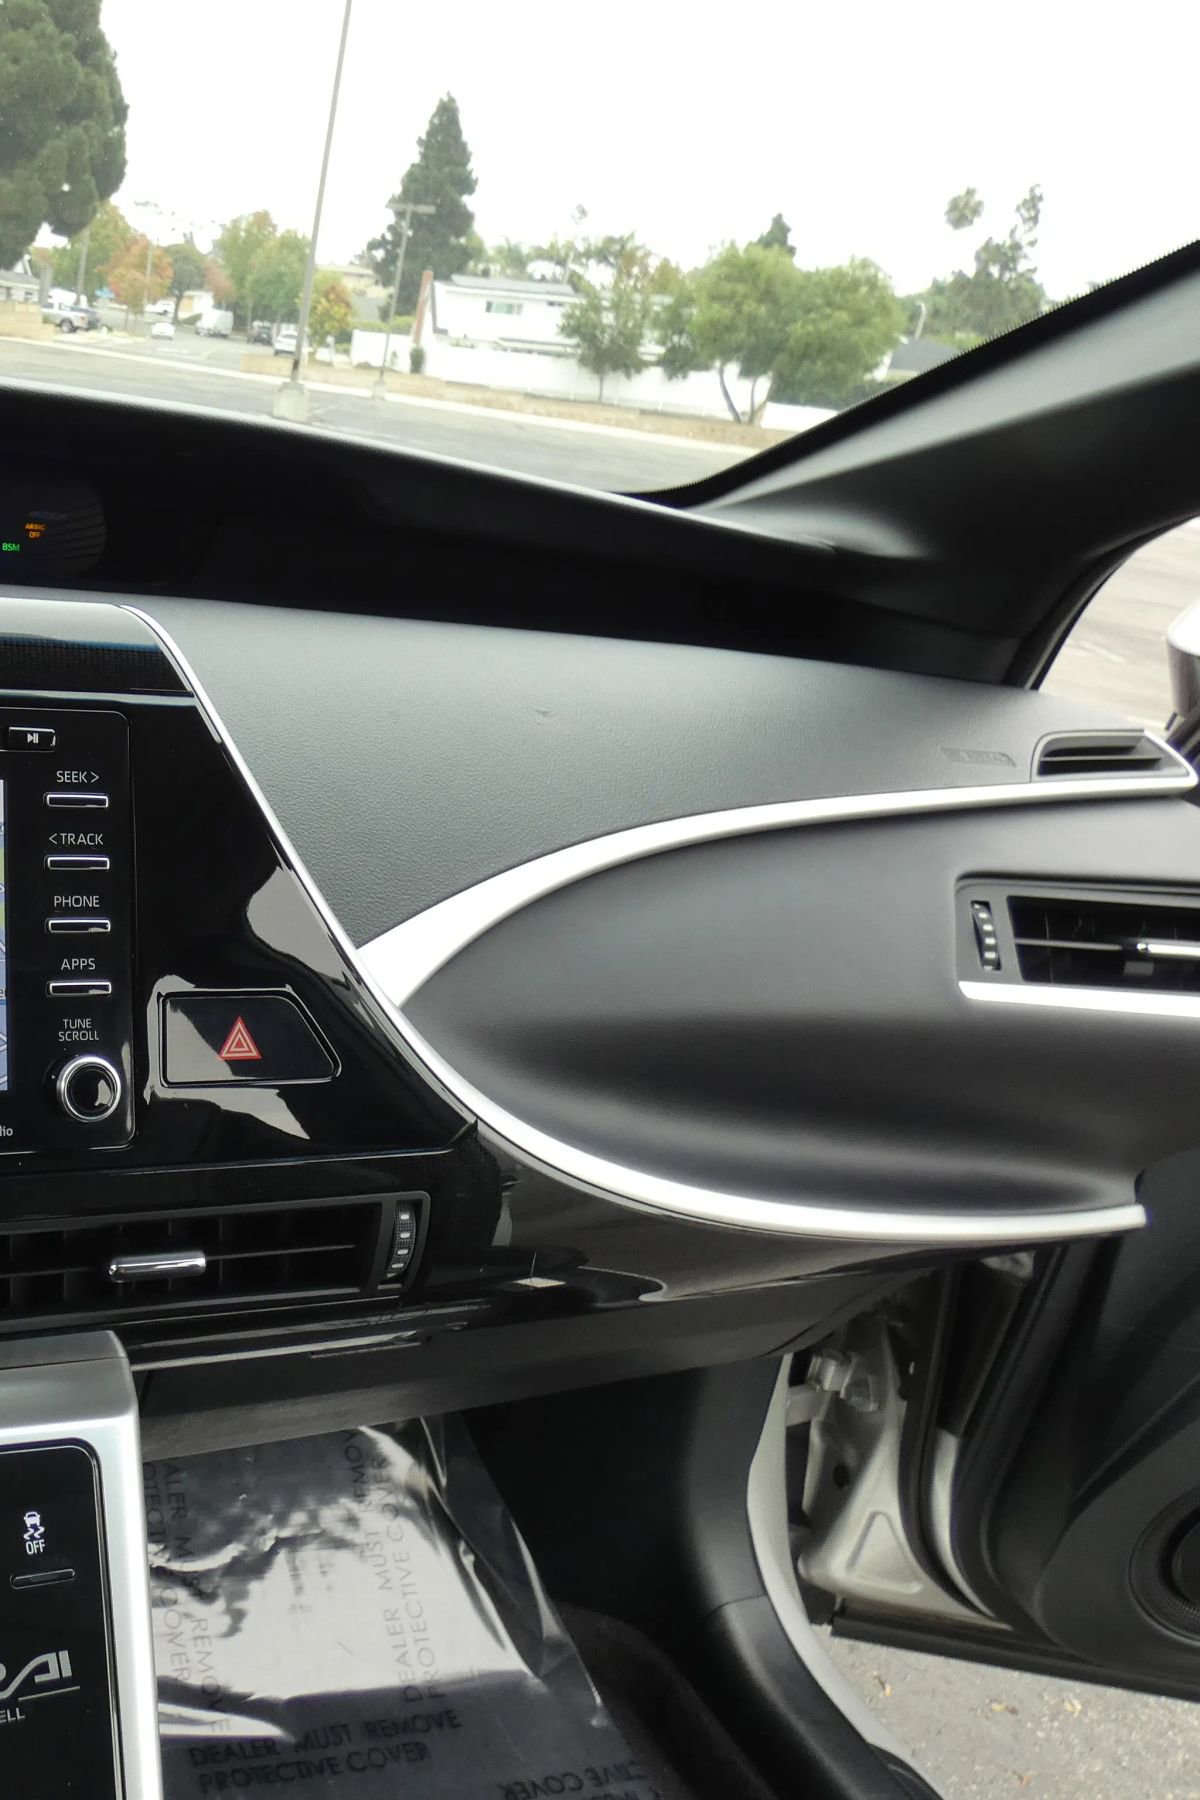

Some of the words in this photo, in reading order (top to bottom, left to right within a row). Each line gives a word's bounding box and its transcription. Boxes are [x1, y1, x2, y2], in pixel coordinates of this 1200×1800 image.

[2, 543, 21, 552] BSM
[53, 895, 100, 908] PHONE
[61, 958, 97, 971] APPS
[62, 1018, 92, 1030] TUNE
[58, 1030, 100, 1042] SCROLL
[25, 1539, 46, 1555] OFF
[364, 1531, 393, 1592] MUST
[382, 1606, 424, 1703] DEALER
[188, 1738, 280, 1768] DEALER
[293, 1723, 352, 1754] MUST
[362, 1708, 463, 1739] REMOVE
[197, 1756, 345, 1794] PROTECTIVE
[346, 1741, 433, 1773] COVER
